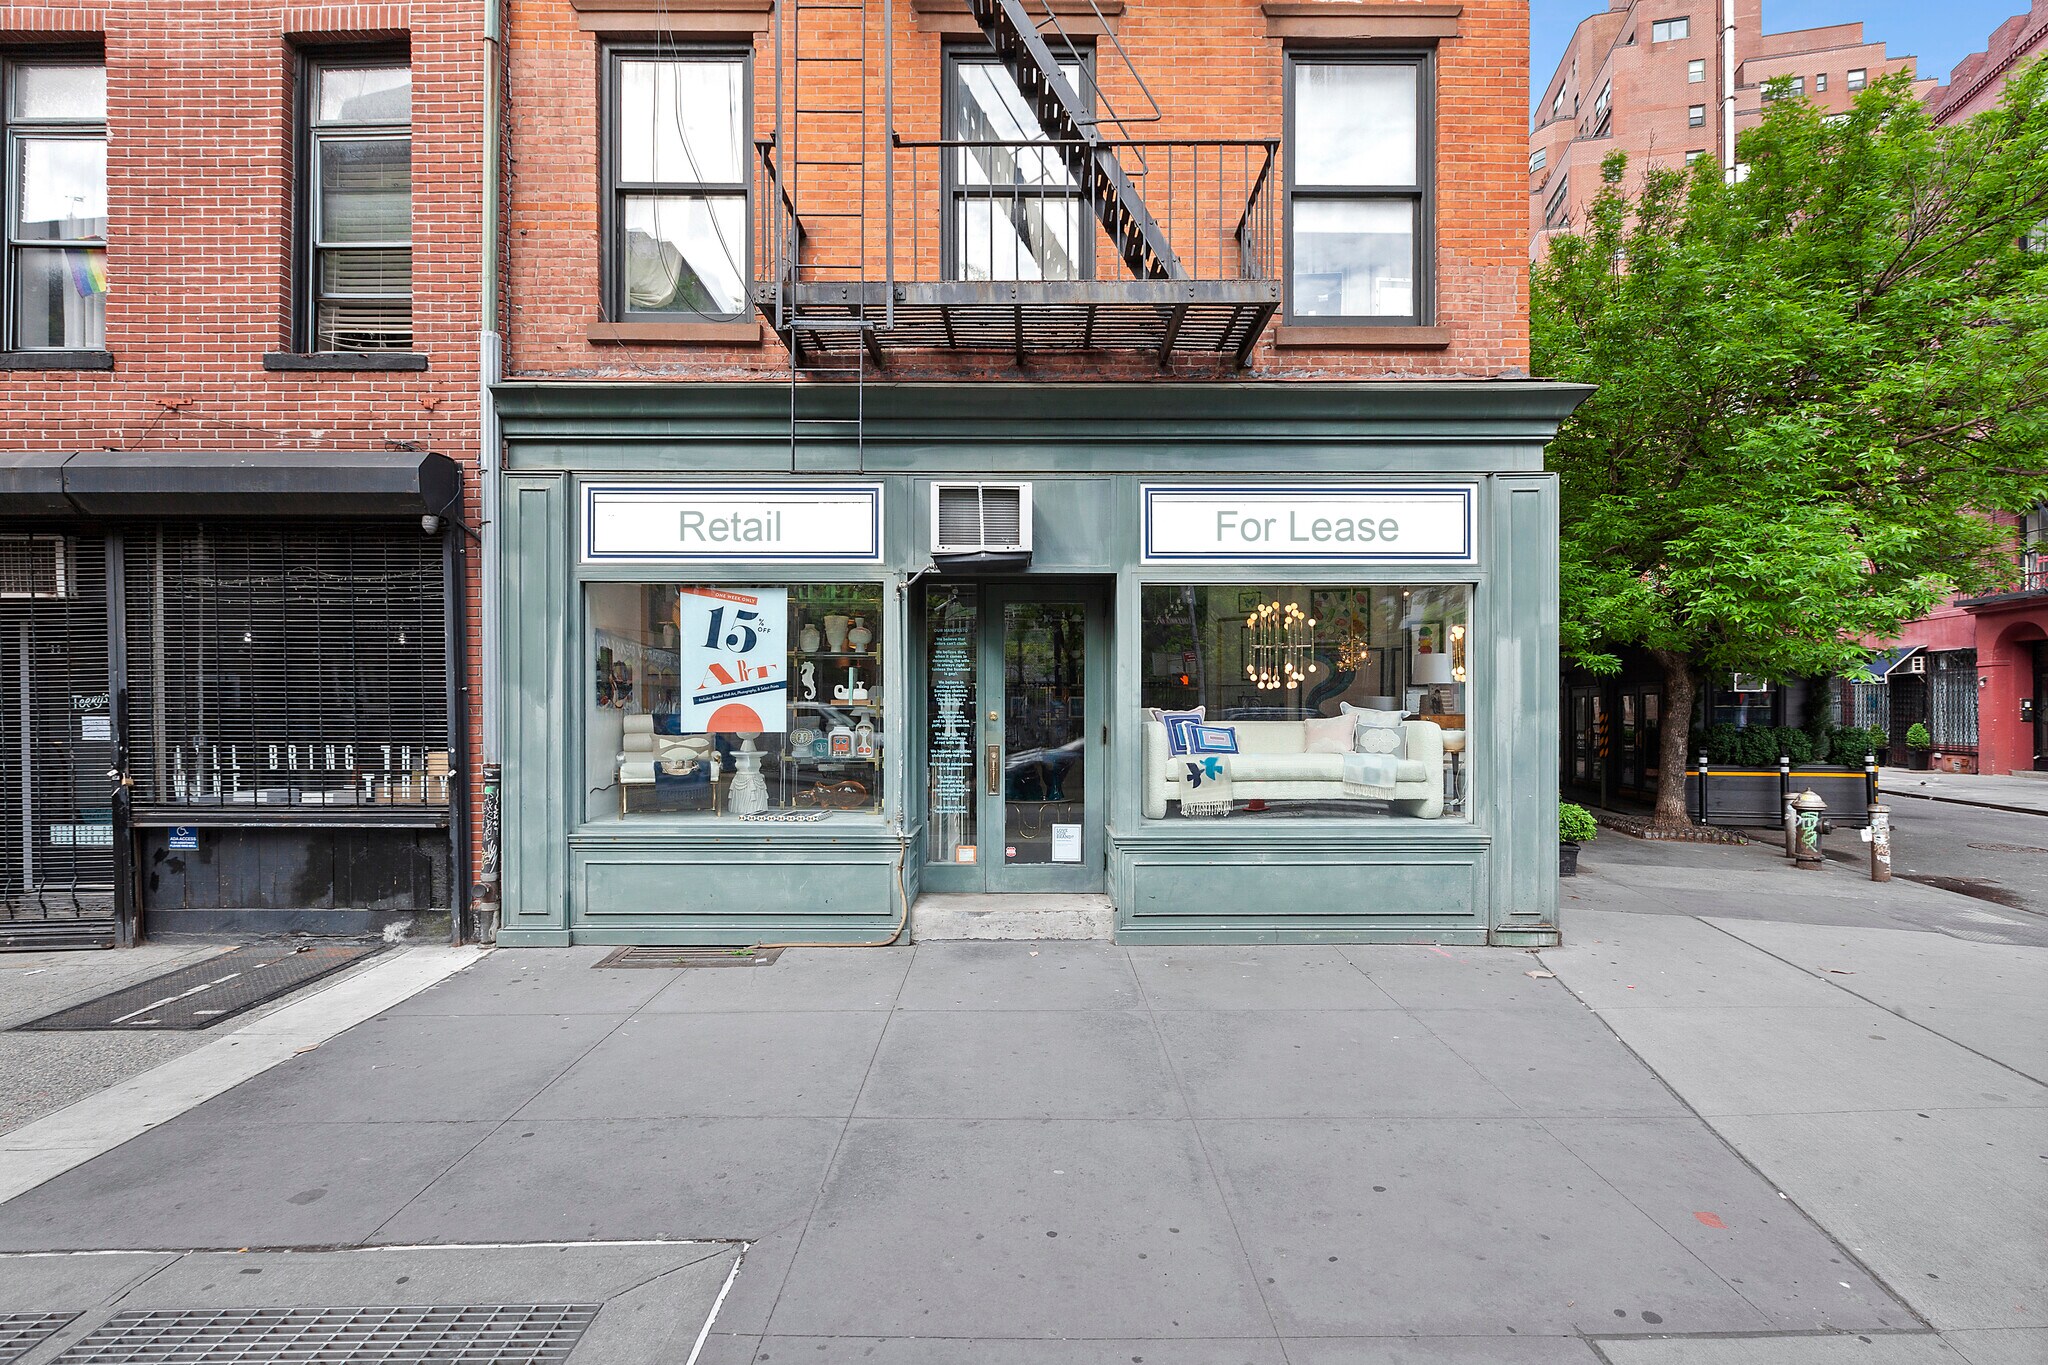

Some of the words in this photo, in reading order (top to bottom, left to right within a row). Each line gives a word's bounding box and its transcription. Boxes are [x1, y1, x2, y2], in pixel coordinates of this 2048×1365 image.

[680, 511, 781, 541] Retail
[1217, 511, 1277, 541] For
[1290, 511, 1399, 541] Lease
[701, 606, 759, 653] 15
[696, 660, 777, 690] ART
[269, 745, 354, 770] BRING
[173, 772, 241, 798] WINE
